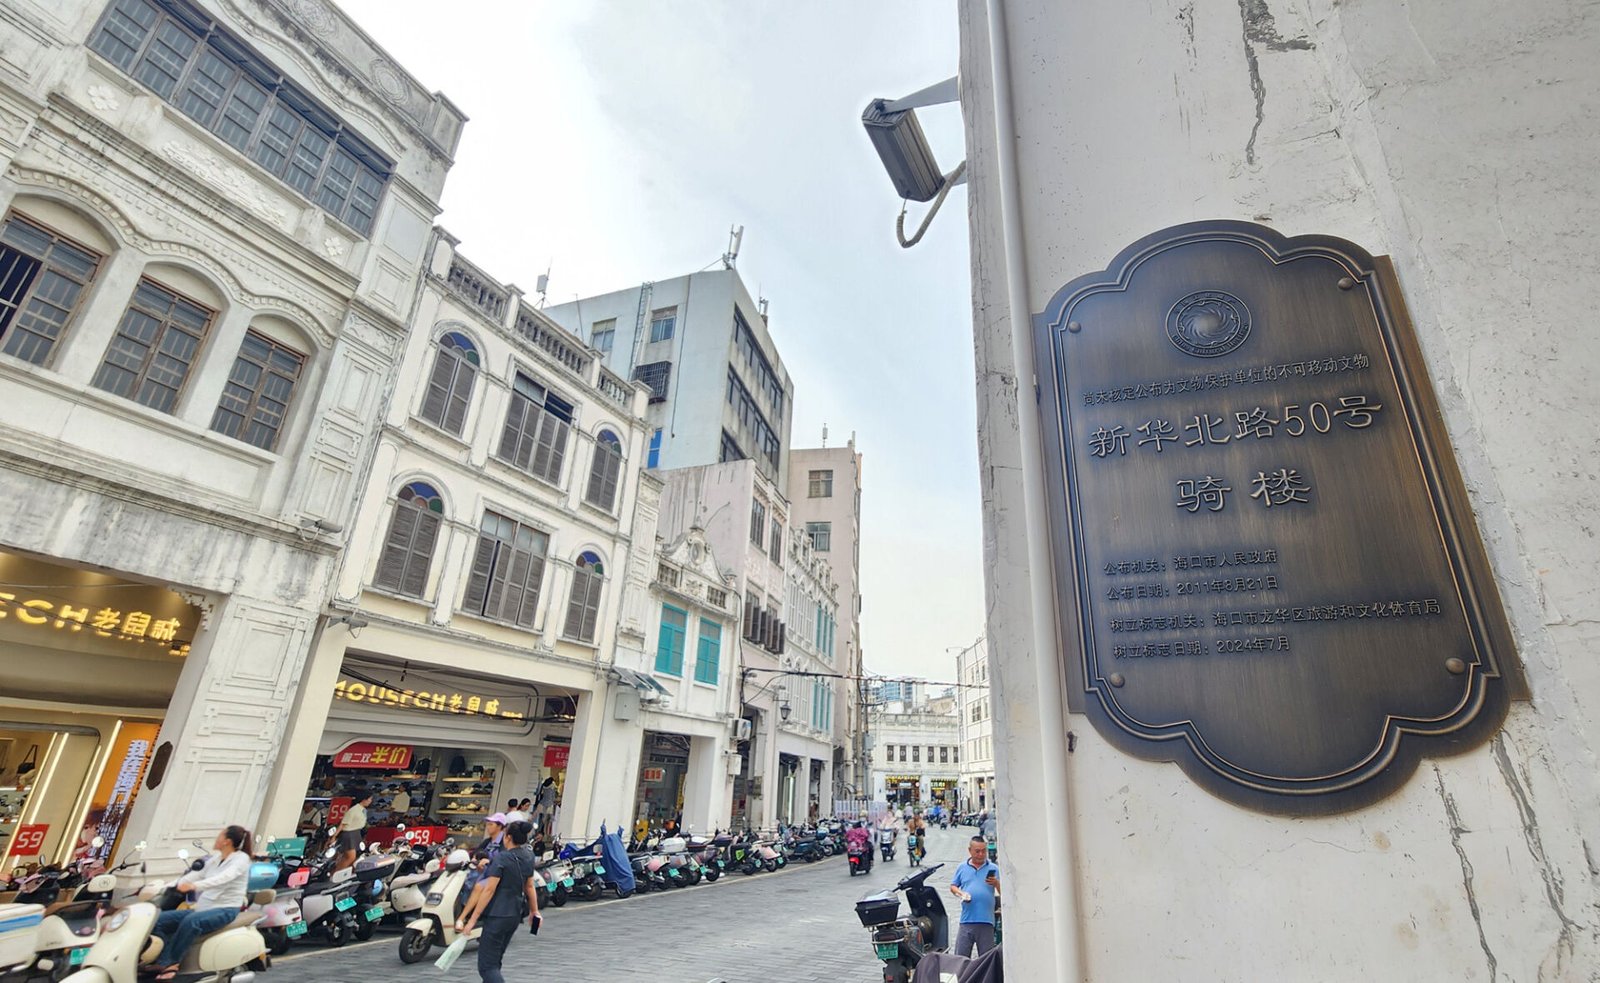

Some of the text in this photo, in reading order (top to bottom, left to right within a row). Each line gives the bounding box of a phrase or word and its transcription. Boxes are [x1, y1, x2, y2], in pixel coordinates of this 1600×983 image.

[1083, 354, 1369, 405] 尚未核定公布为文物保护单位的不可移动文物
[1088, 396, 1382, 457] 新华北路50号
[1177, 468, 1311, 512] 骑楼
[16, 831, 44, 848] 59
[414, 829, 430, 846] 59
